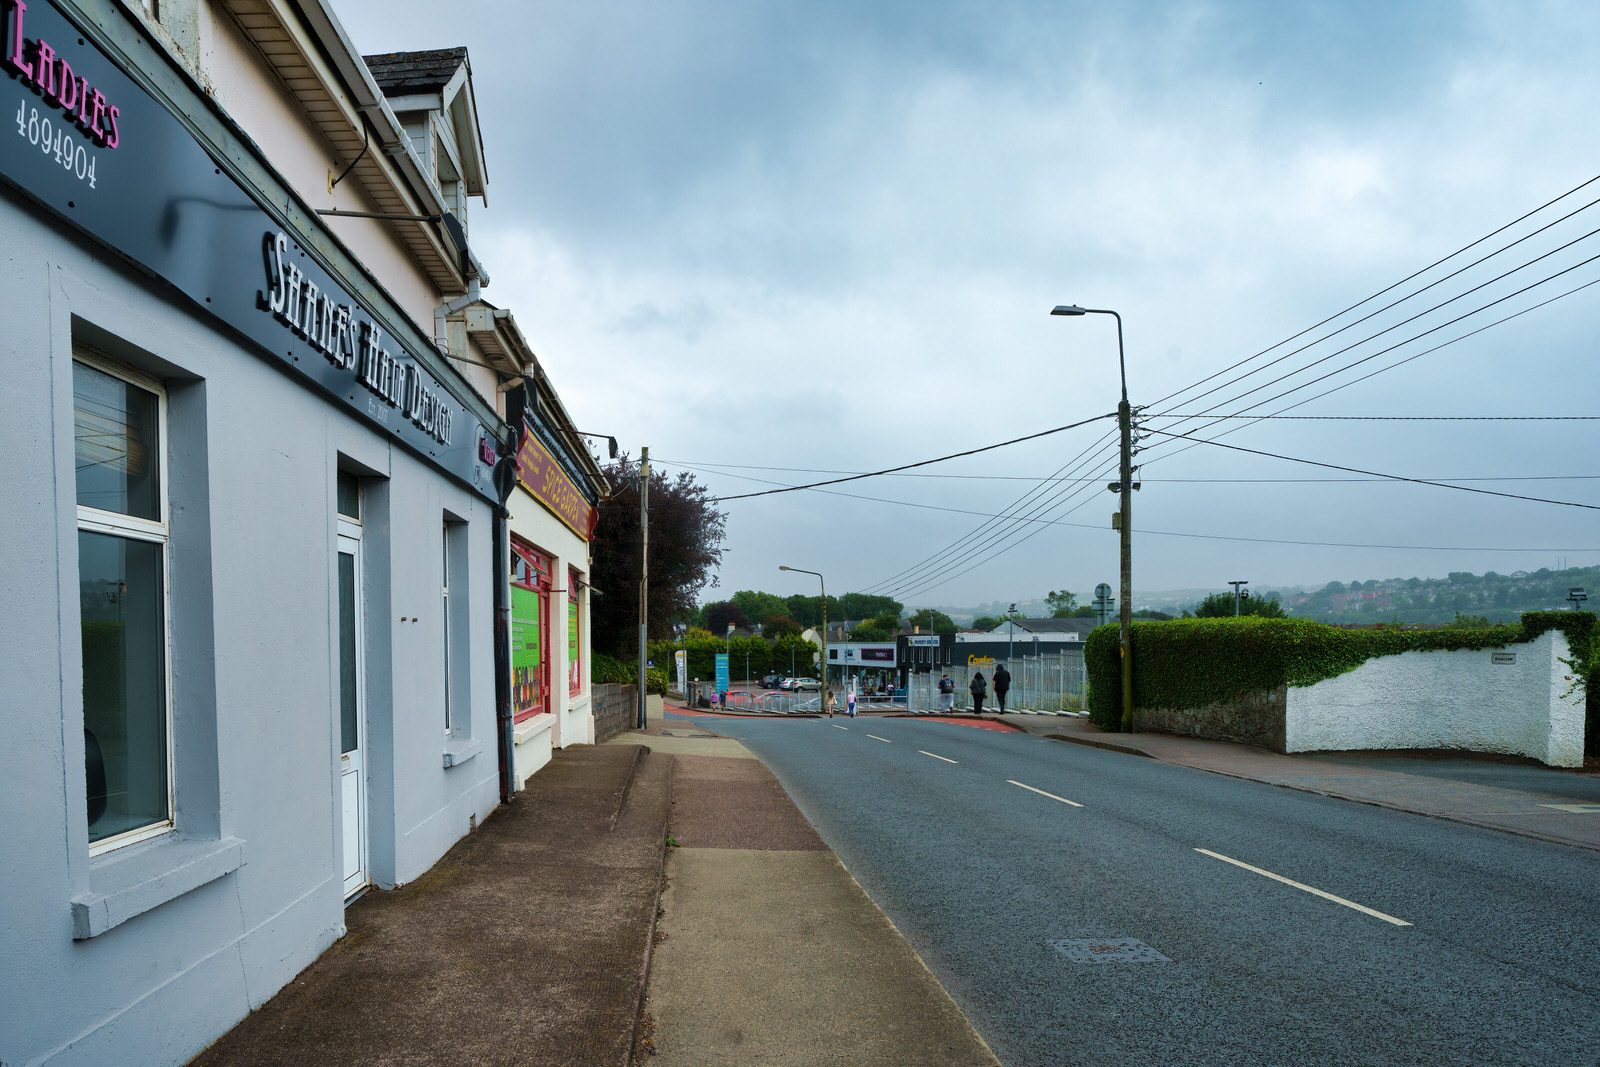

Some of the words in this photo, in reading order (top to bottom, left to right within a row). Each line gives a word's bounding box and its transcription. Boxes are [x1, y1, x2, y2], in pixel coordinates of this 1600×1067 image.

[10, 0, 120, 149] LADIES
[16, 99, 97, 190] 4894904
[270, 231, 358, 370] SHANE'S
[364, 320, 406, 411] HAIR
[410, 363, 453, 447] DESIGN
